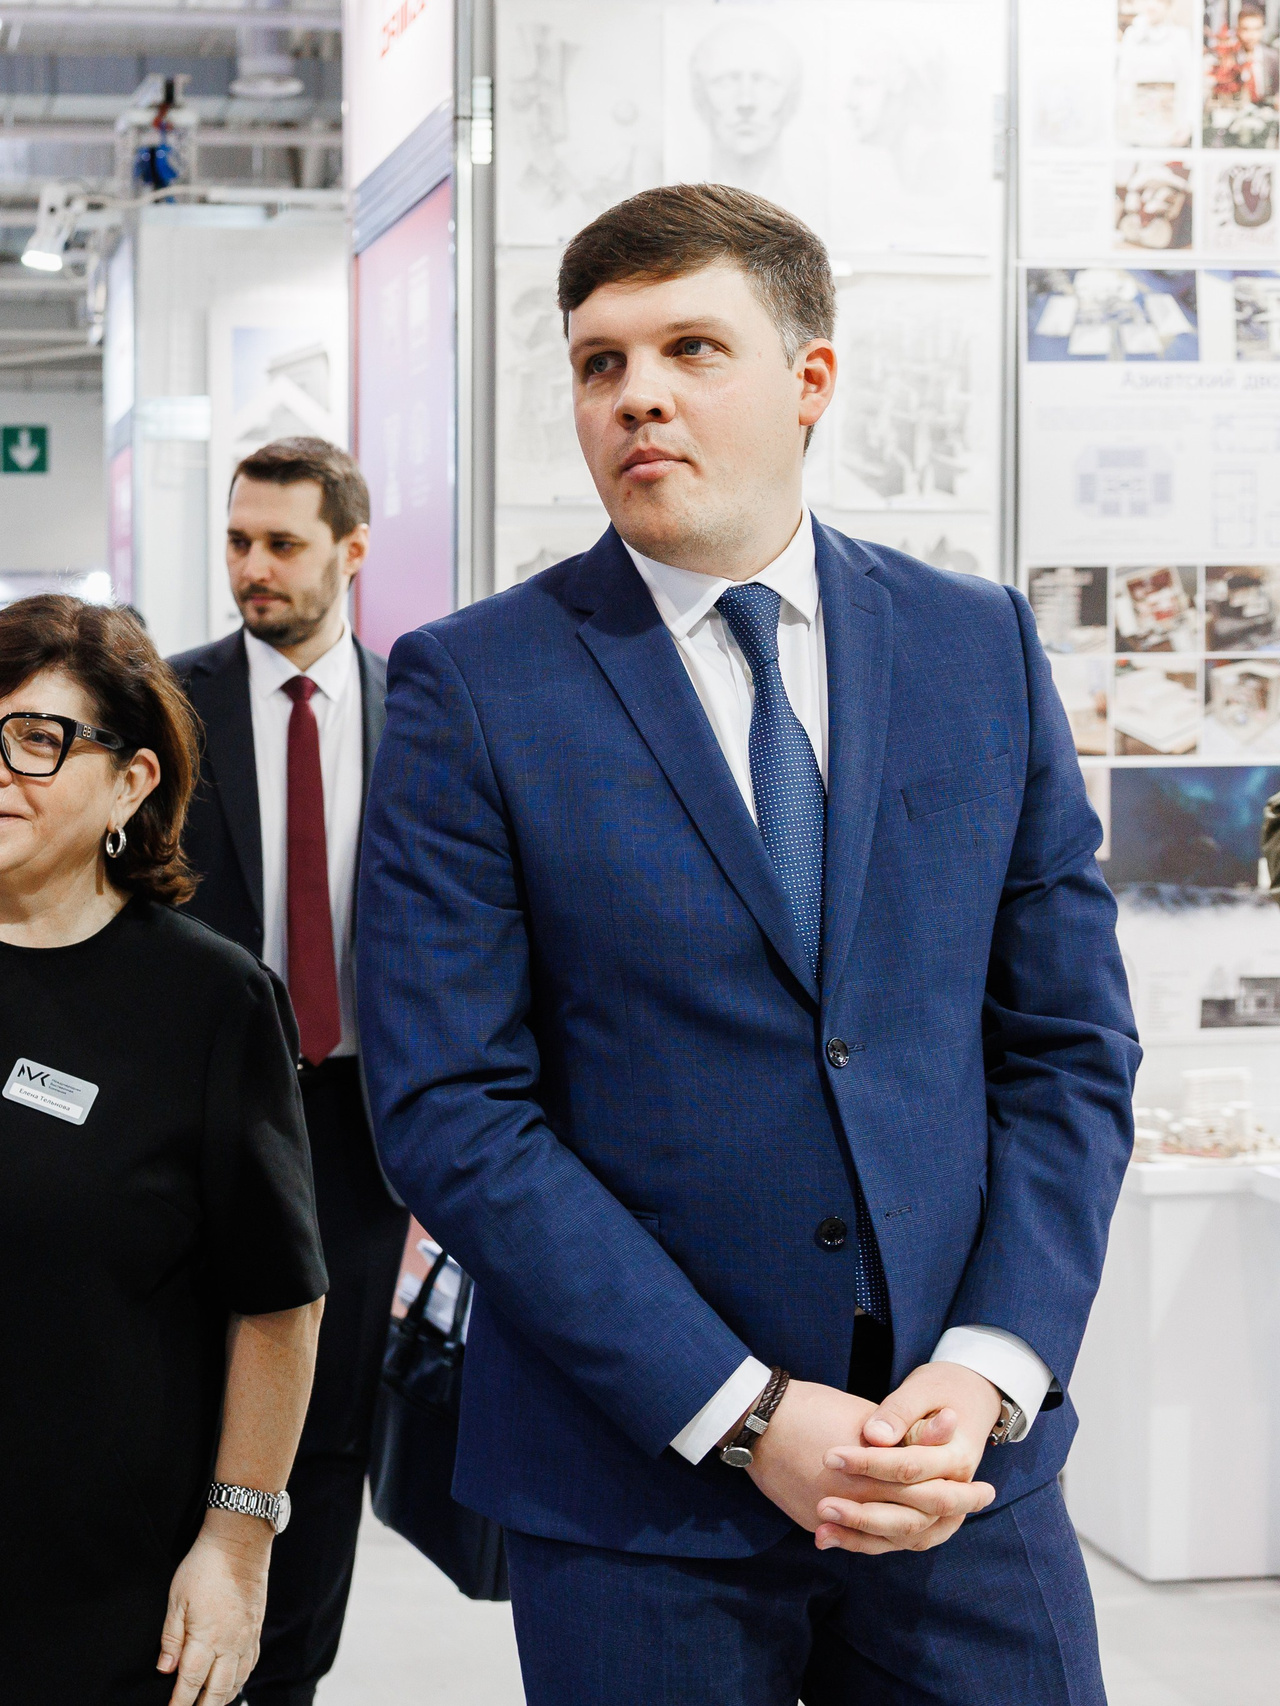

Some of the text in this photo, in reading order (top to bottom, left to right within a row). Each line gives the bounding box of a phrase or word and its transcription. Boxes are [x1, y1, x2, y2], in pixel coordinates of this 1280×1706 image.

[1120, 369, 1236, 390] Азиатский
[19, 1088, 71, 1112] Елена Тельнова
